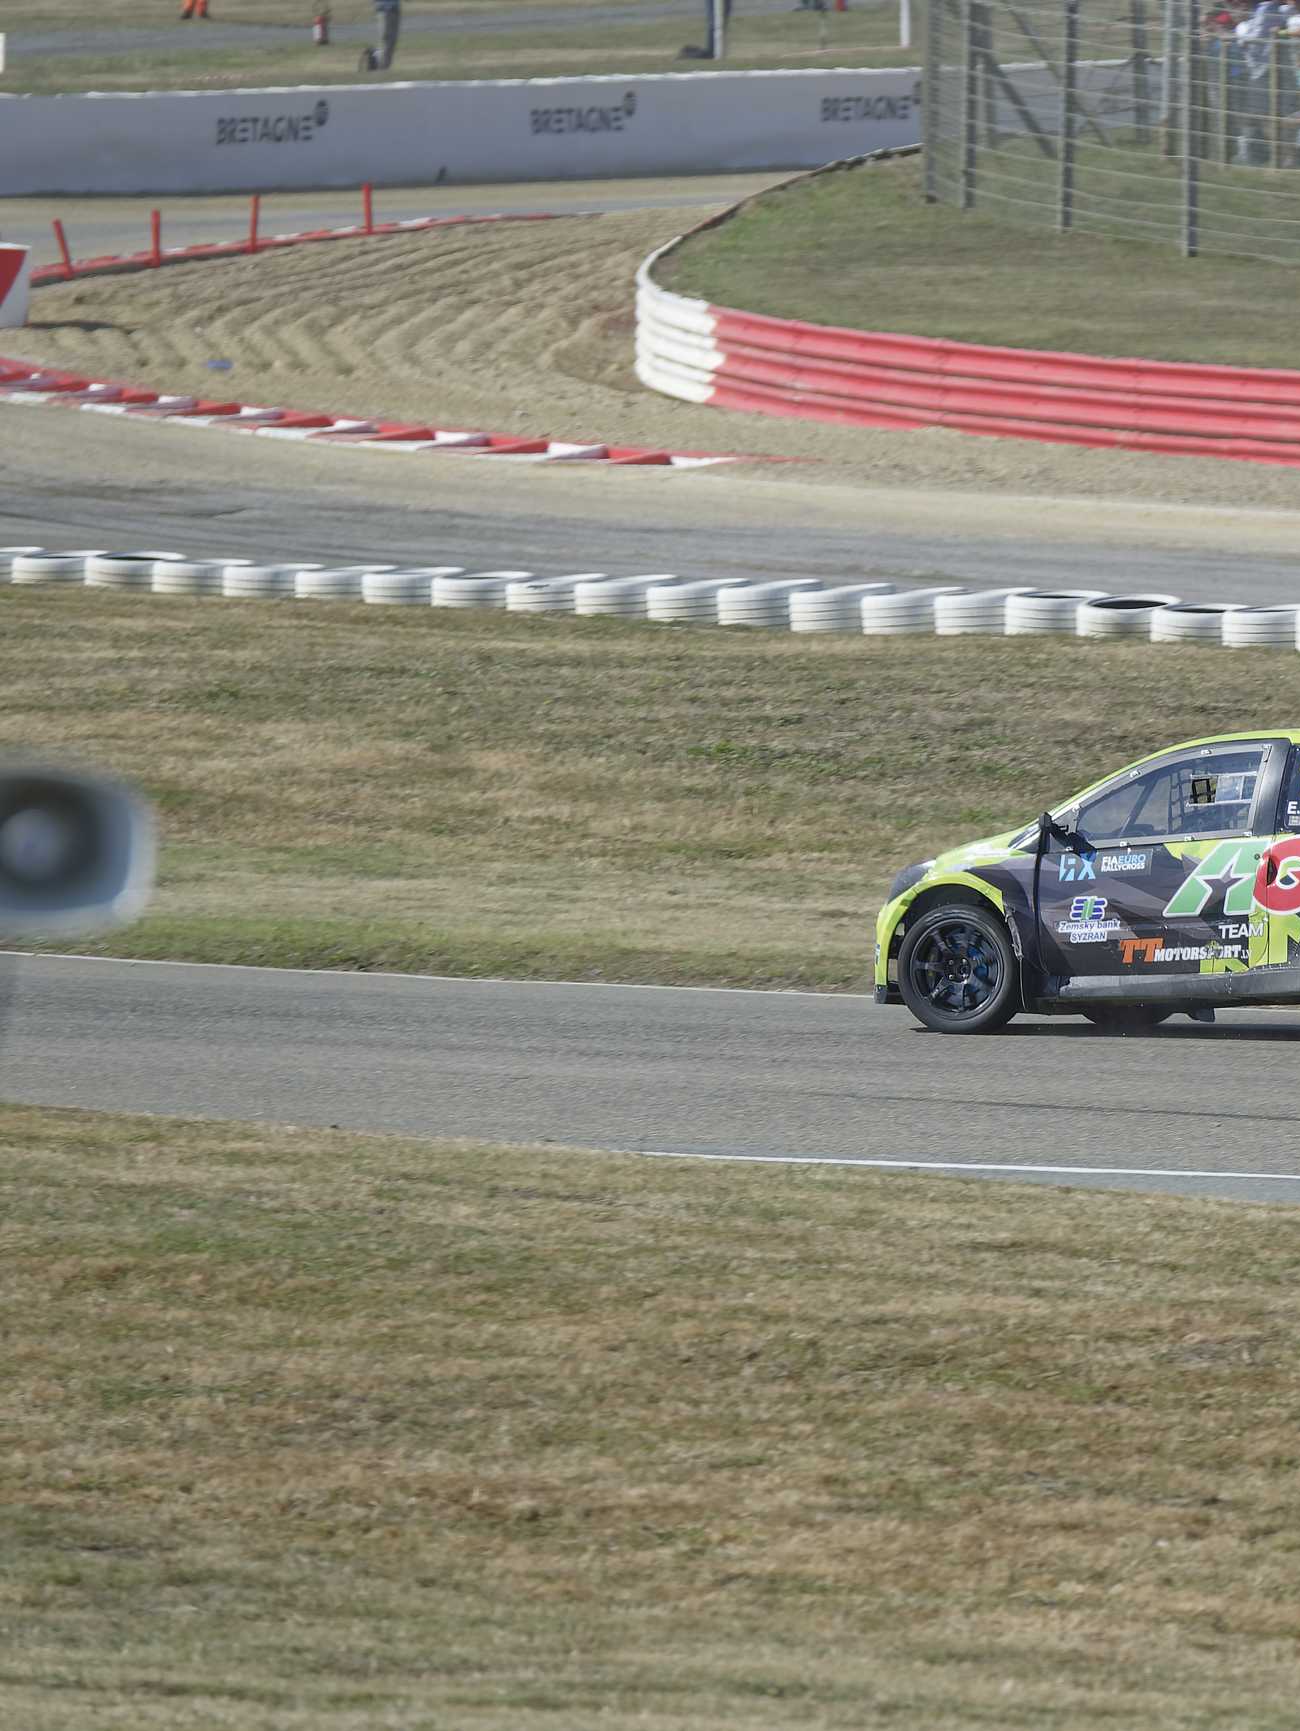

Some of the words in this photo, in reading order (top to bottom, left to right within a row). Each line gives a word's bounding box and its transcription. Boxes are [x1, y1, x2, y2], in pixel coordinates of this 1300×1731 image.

[821, 96, 911, 122] BRETAGNE
[530, 107, 624, 134] BRETAGNE
[216, 115, 313, 145] BRETAGNE
[1100, 862, 1146, 873] RALLYCROSS
[1059, 921, 1095, 933] Zemsky
[1097, 919, 1120, 930] bank
[1218, 922, 1264, 939] TEAM
[1070, 931, 1106, 941] SYZRAN
